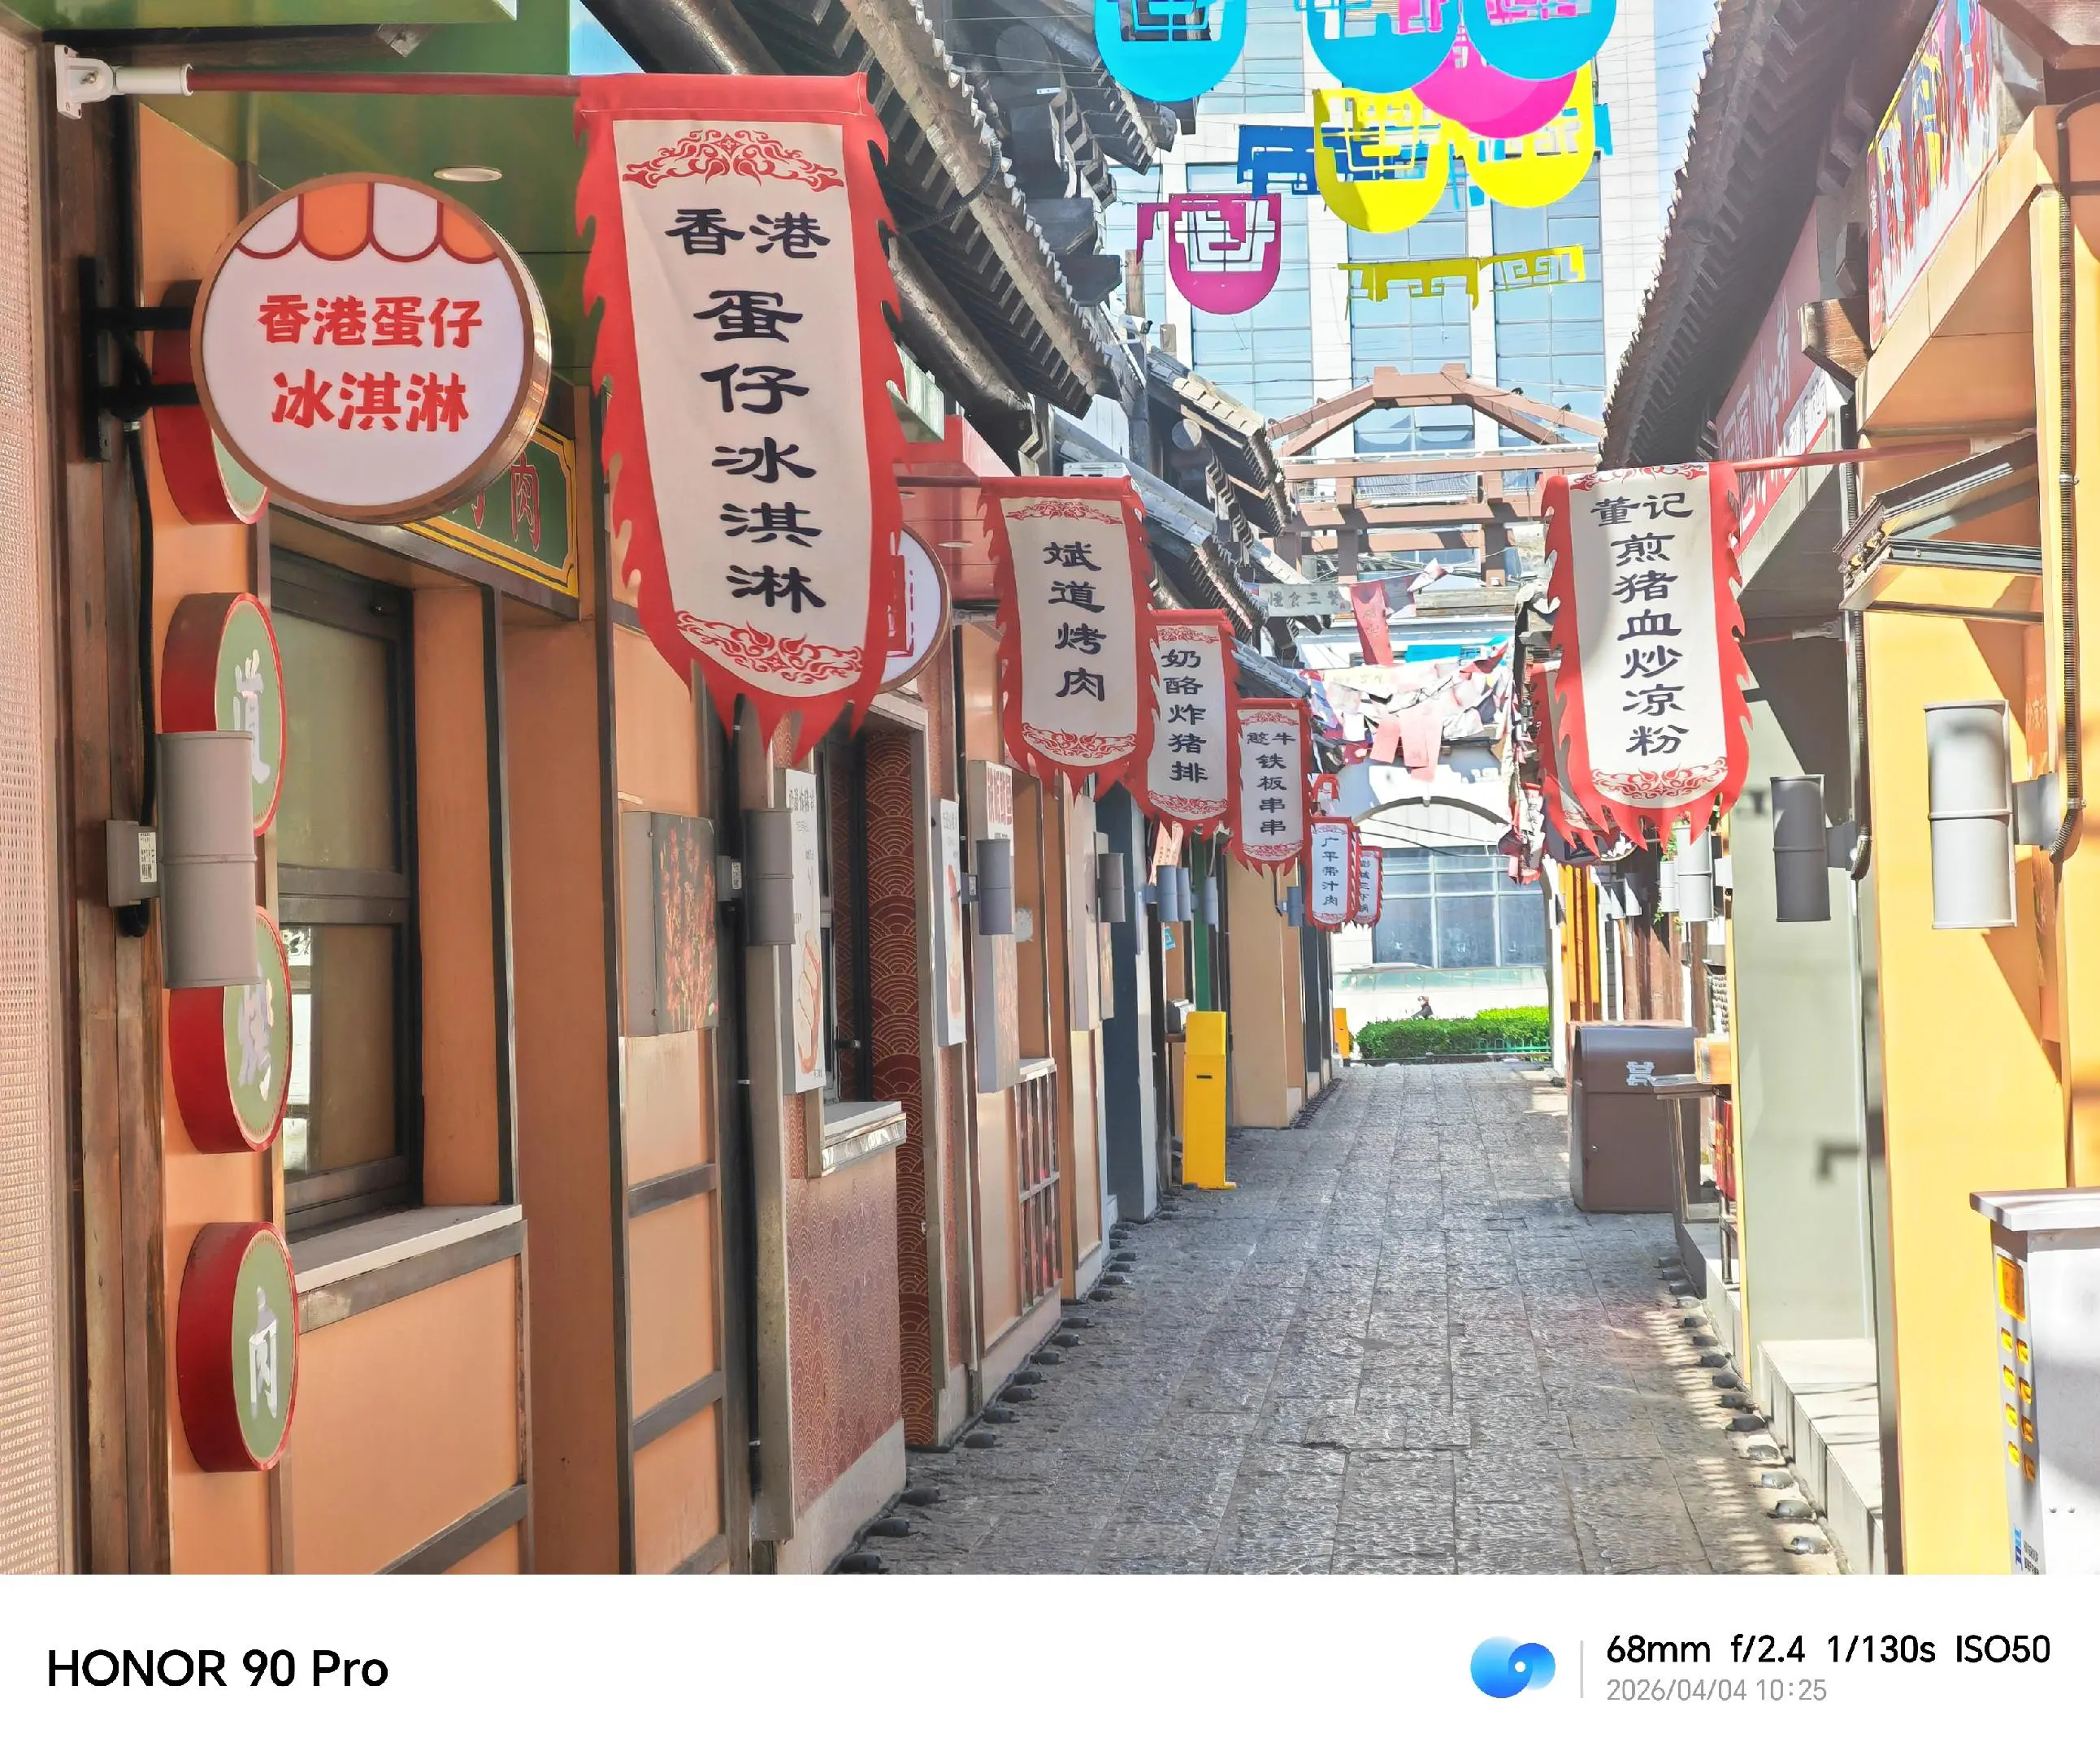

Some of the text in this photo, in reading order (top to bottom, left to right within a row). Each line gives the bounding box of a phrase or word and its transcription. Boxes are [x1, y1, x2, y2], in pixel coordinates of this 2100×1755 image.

[665, 209, 830, 258] 香港
[258, 294, 483, 349] 香港蛋仔
[271, 369, 469, 433] 冰淇淋
[693, 290, 827, 614] 蛋仔冰淇淋
[1590, 492, 1693, 527] 董记
[1043, 541, 1107, 701] 斌道烤肉
[1611, 533, 1688, 756] 煎猪血炒凉粉
[1161, 648, 1209, 783] 奶酪炸猪排
[1256, 752, 1287, 836] 铁板串串
